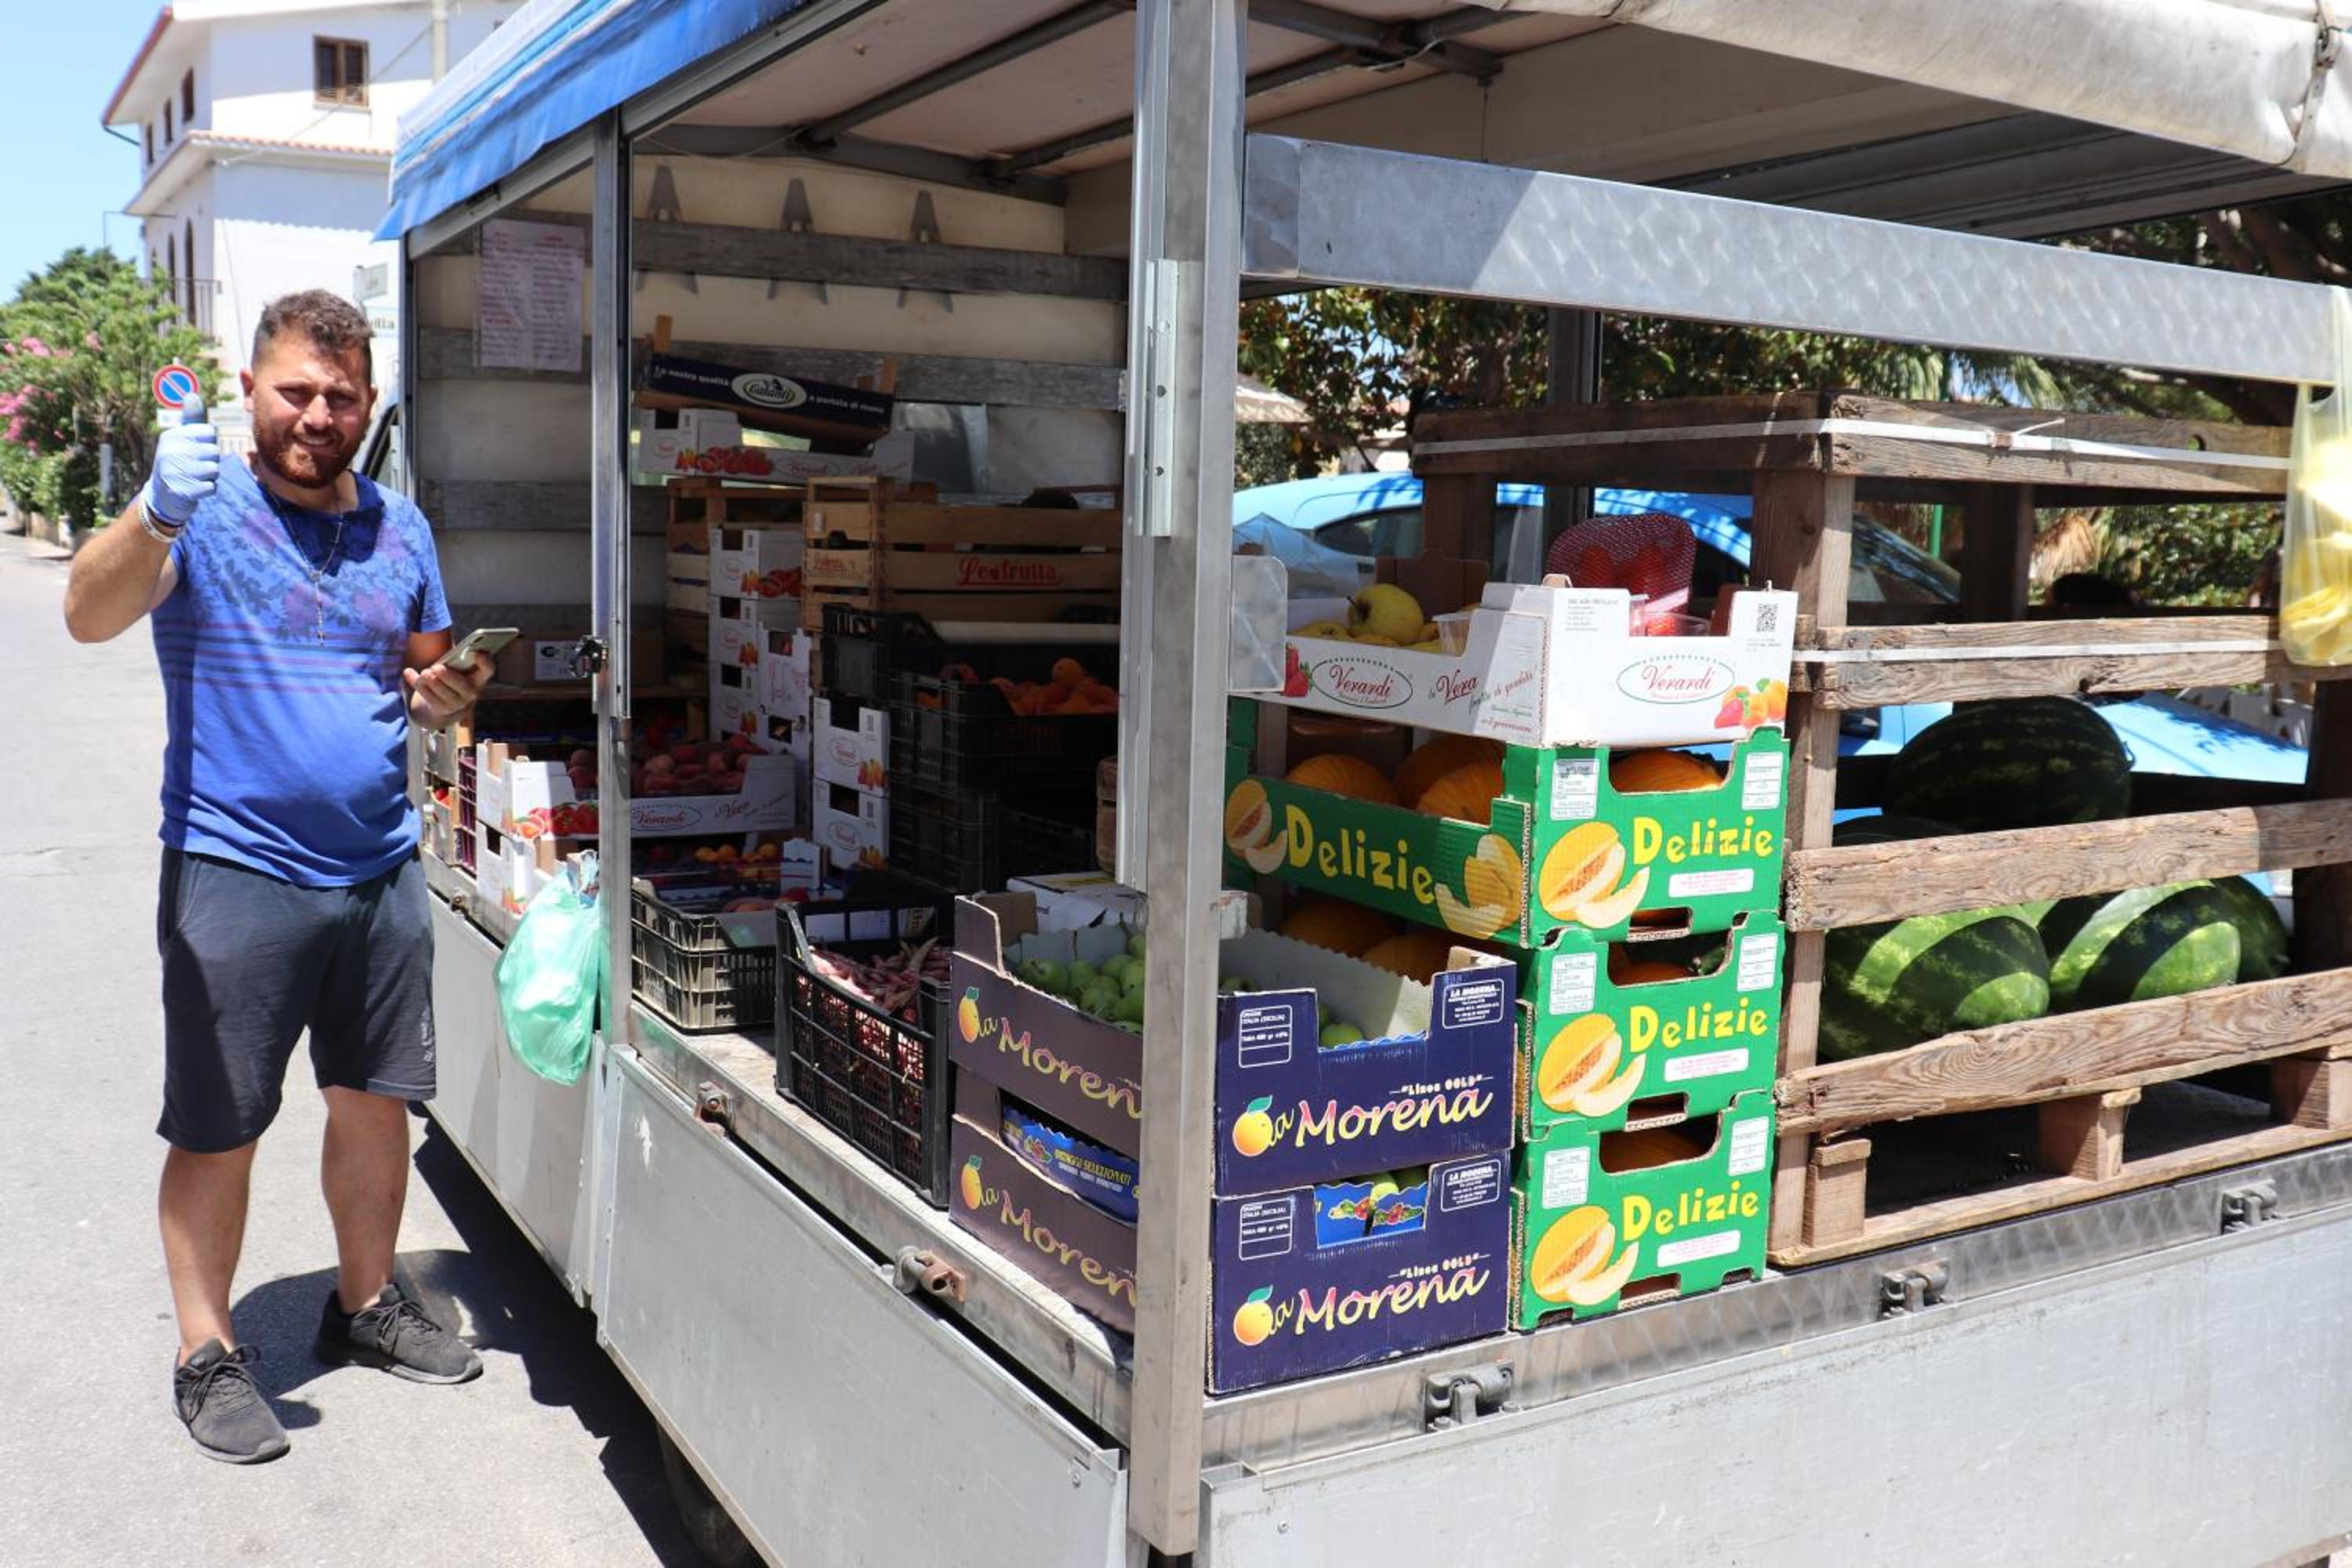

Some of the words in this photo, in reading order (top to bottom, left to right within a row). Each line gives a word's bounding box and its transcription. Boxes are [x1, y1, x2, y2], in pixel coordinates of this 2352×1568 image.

[1330, 664, 1393, 699] Verardi
[1436, 667, 1479, 704] Vera
[1641, 664, 1717, 691] Verardi
[1286, 803, 1436, 905] Delizie
[1633, 815, 1773, 866] Delizie
[1450, 988, 1461, 998] LA
[1630, 997, 1768, 1053] Delizie
[998, 1017, 1142, 1119] Moren
[1294, 1087, 1494, 1148] Morena
[1449, 1172, 1458, 1181] LA
[1623, 1180, 1759, 1241] Delizie
[1000, 1189, 1137, 1307] Moren
[1294, 1267, 1490, 1335] Morena
